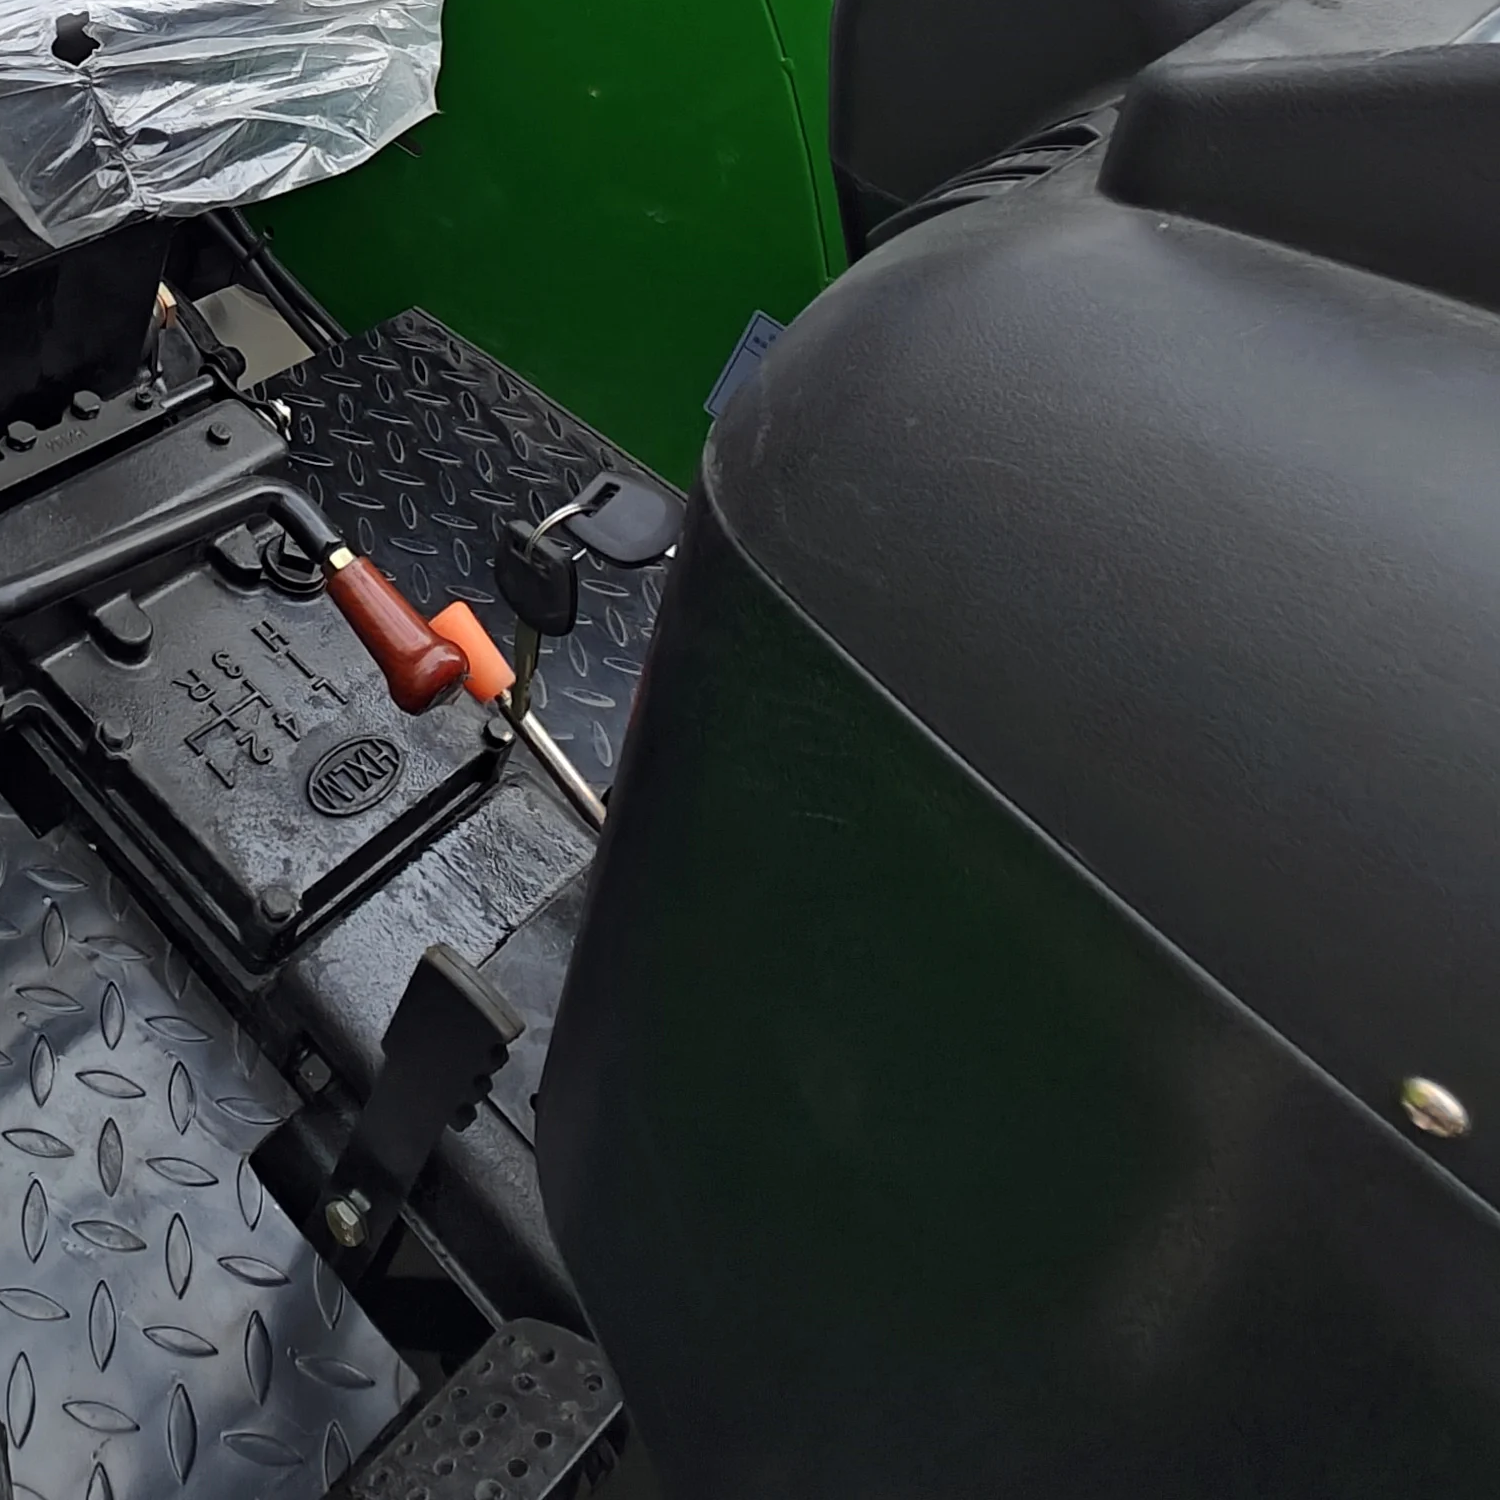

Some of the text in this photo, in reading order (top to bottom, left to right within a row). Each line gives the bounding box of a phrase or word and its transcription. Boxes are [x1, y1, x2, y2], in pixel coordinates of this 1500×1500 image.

[172, 650, 243, 702] 3 R
[236, 730, 273, 765] 2
[272, 711, 304, 741] 4
[314, 738, 399, 810] HXLM
